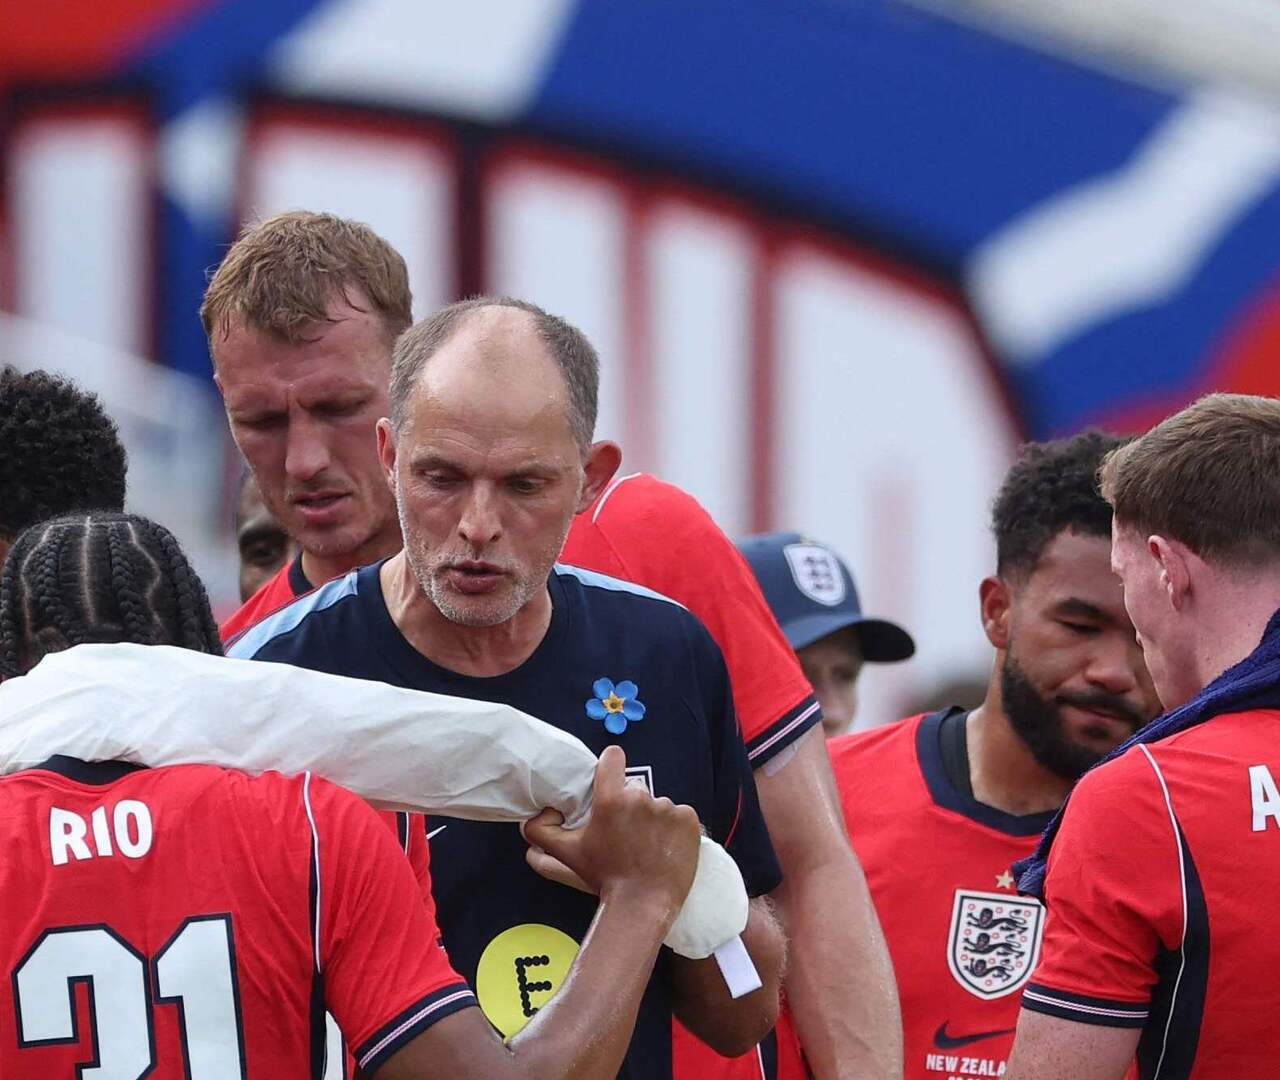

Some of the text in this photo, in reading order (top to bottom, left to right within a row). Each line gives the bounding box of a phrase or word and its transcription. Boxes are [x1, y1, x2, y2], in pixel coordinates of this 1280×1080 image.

[49, 799, 154, 866] RIO
[926, 1054, 1008, 1076] NEW ZEALA
